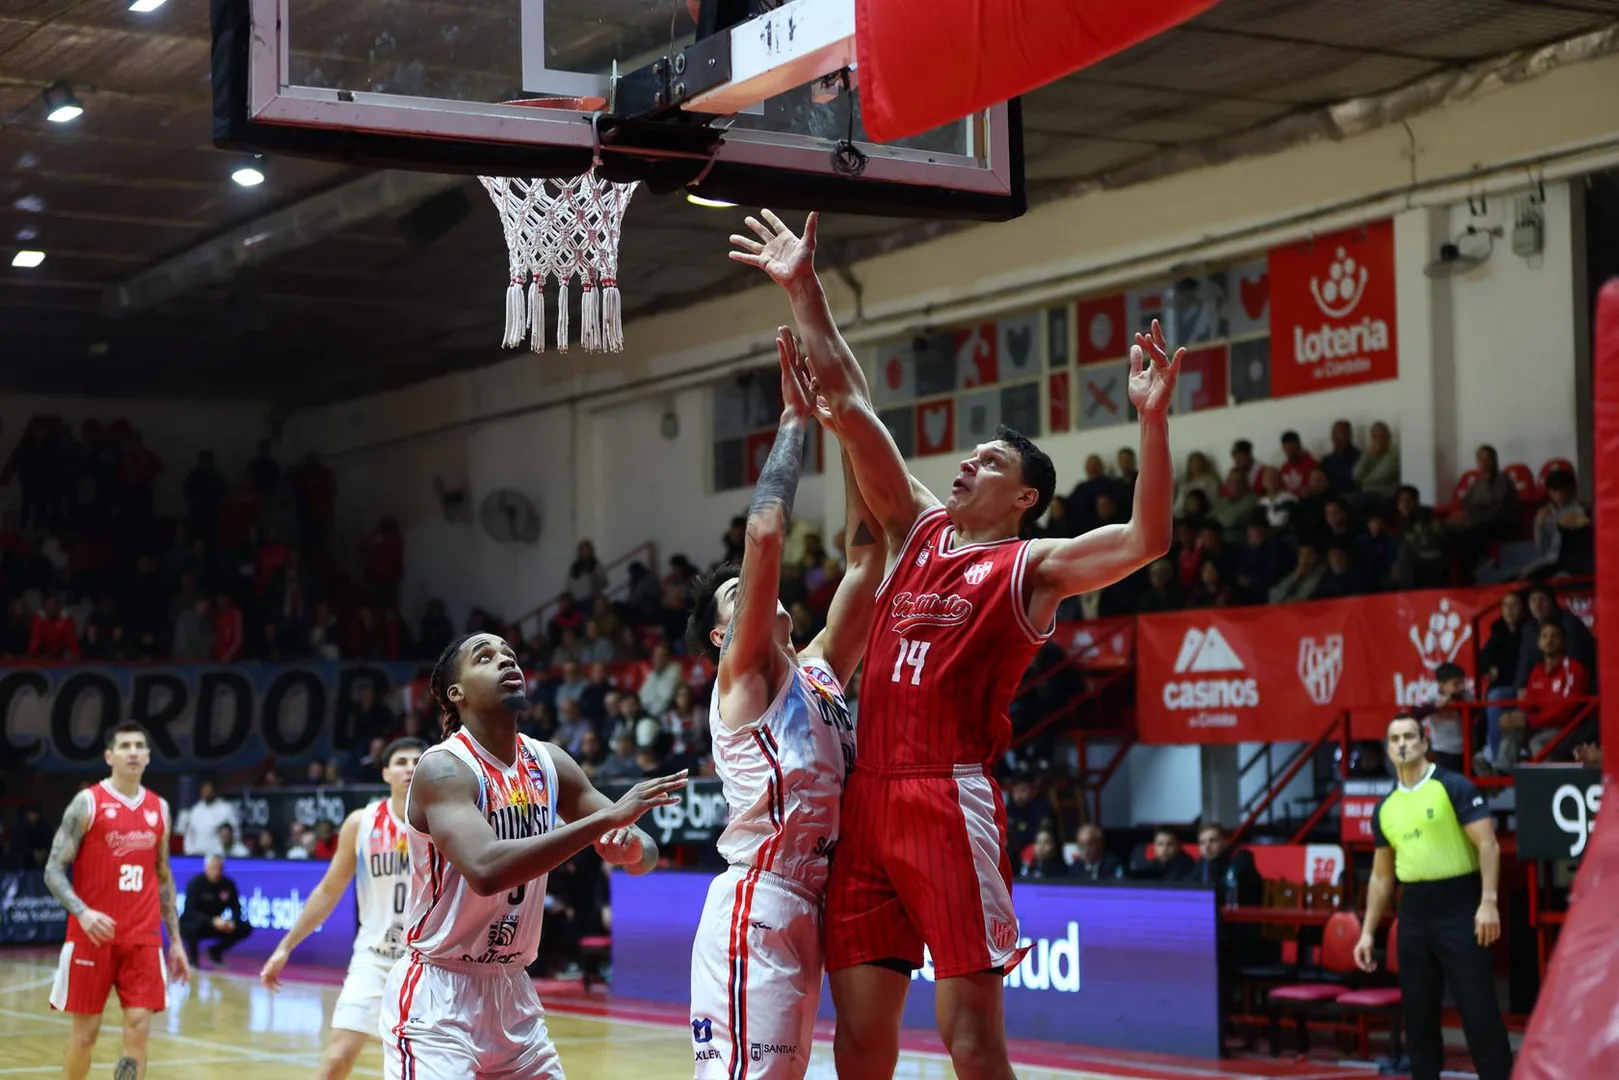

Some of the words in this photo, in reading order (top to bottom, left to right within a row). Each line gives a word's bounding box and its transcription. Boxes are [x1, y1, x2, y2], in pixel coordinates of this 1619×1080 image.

[892, 638, 930, 685] 14
[1162, 677, 1260, 710] casinos
[118, 864, 144, 892] 20
[393, 882, 407, 914] 0
